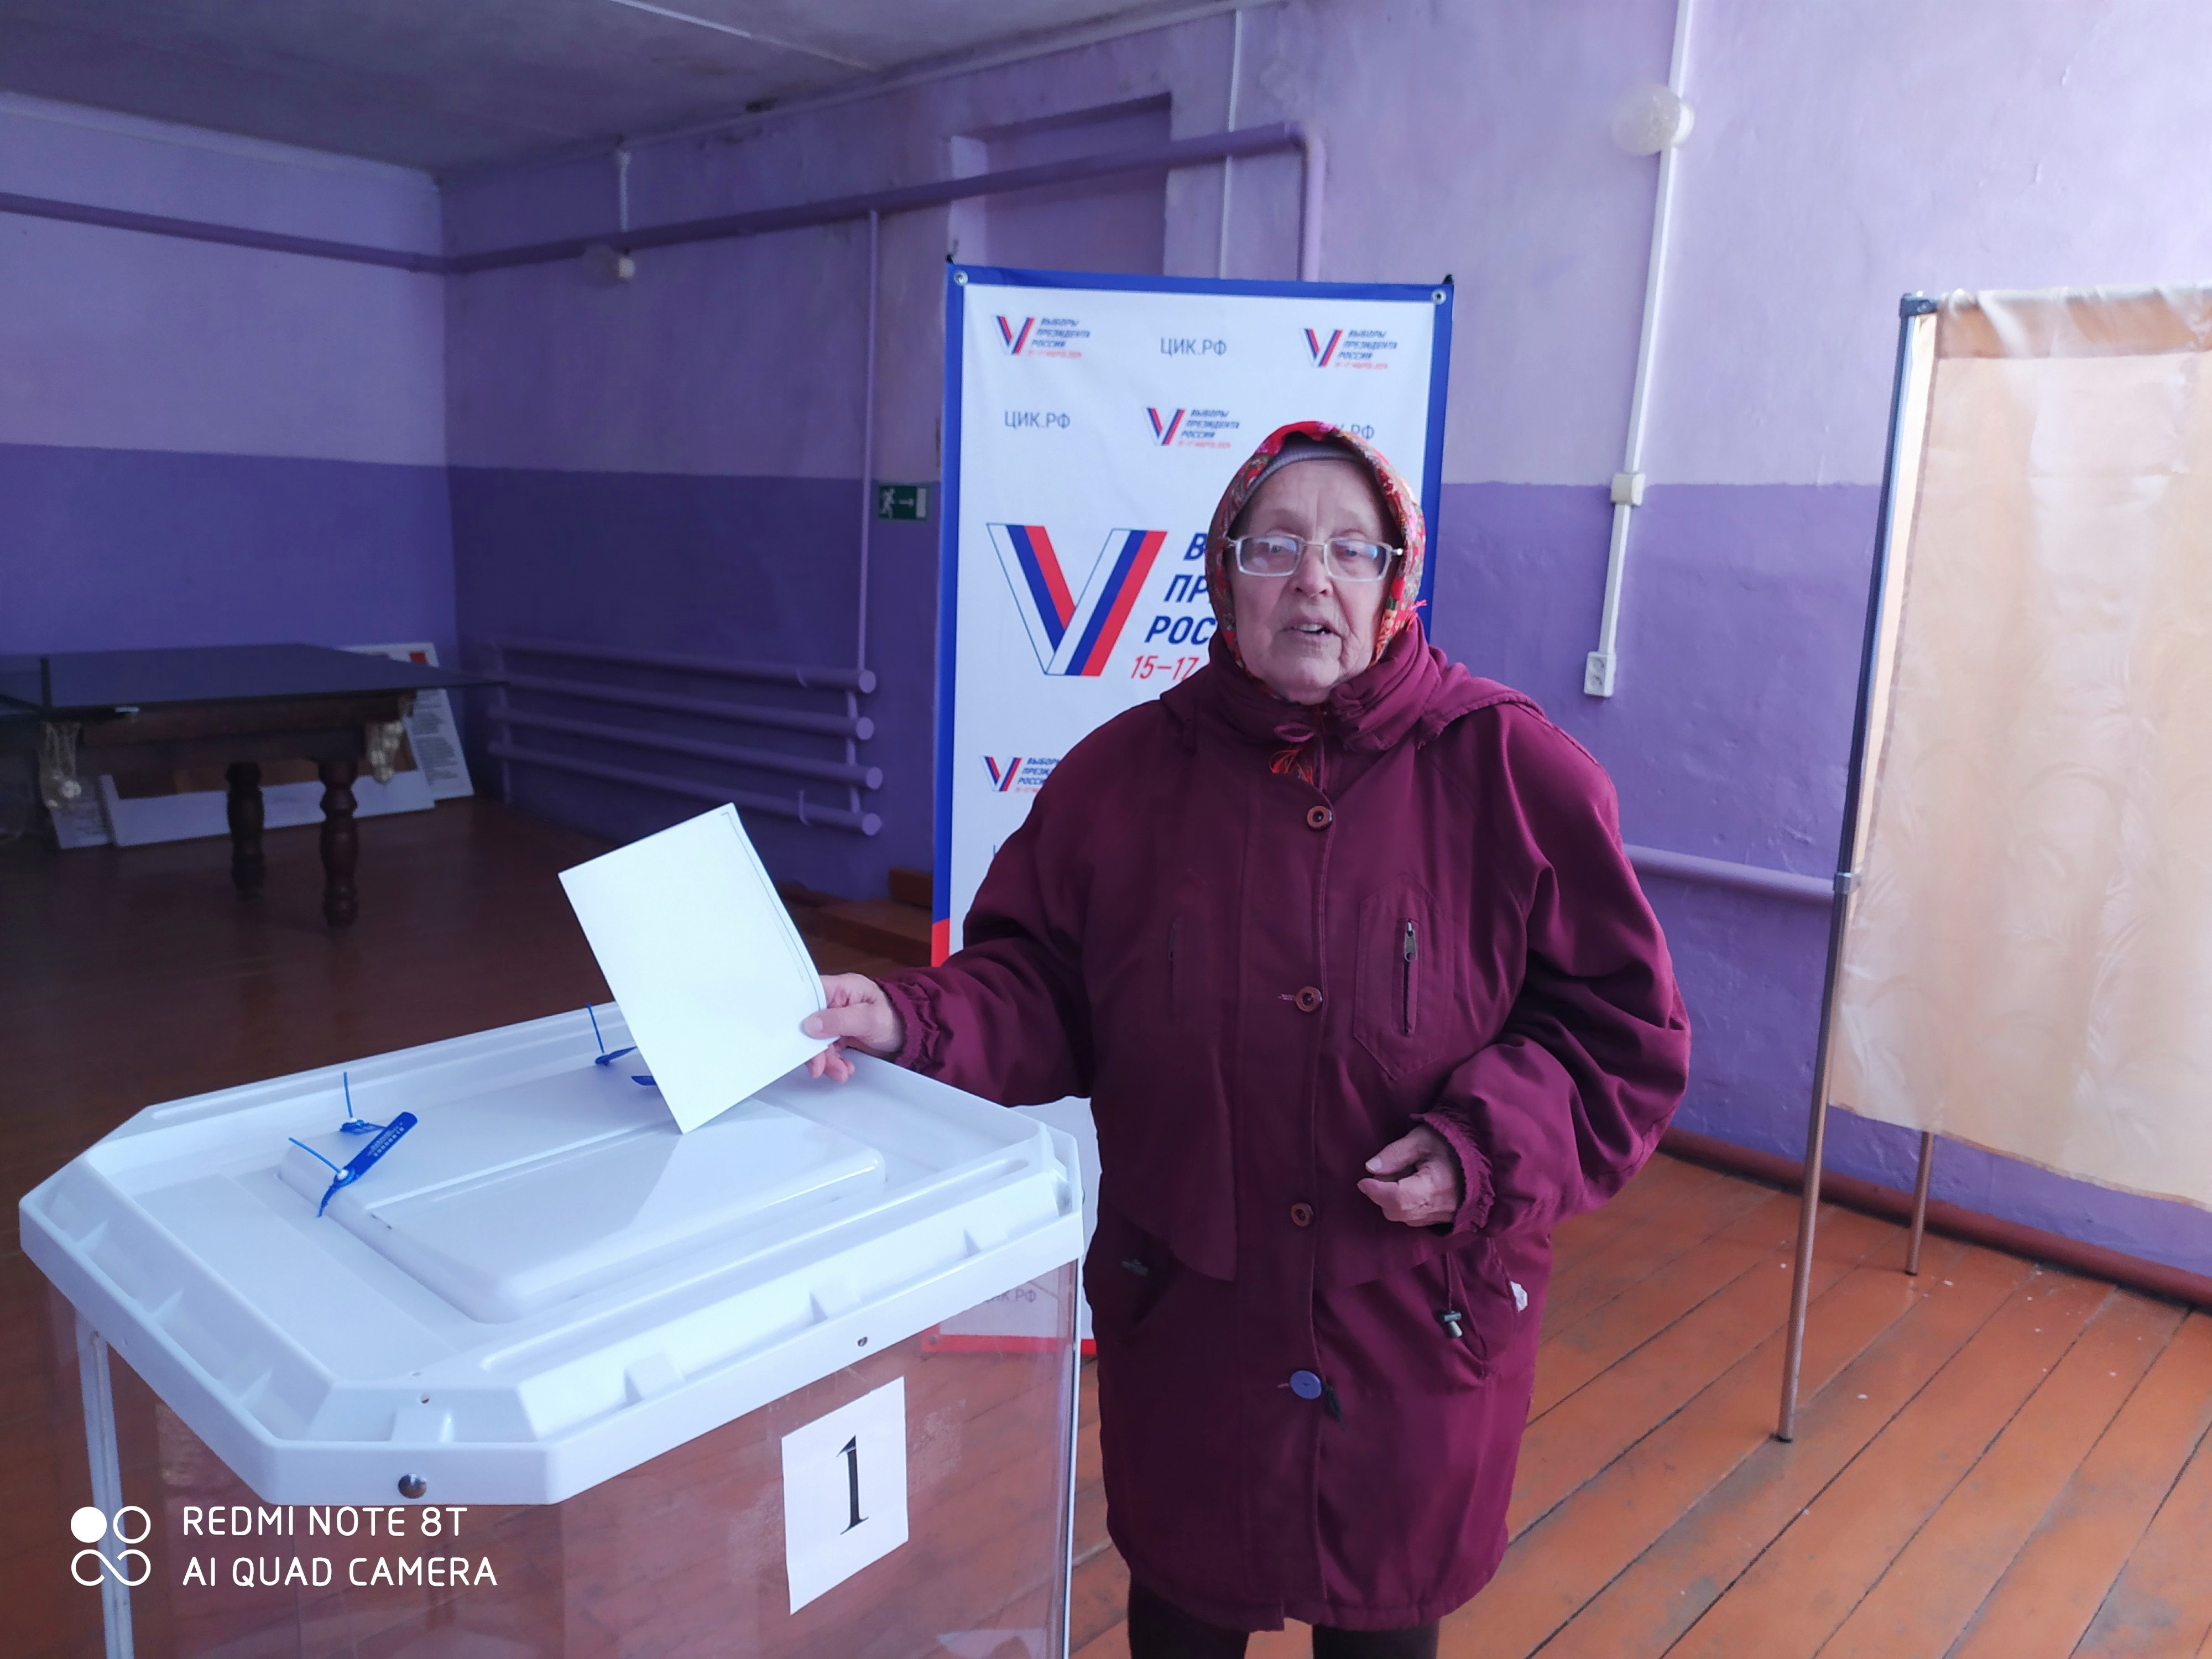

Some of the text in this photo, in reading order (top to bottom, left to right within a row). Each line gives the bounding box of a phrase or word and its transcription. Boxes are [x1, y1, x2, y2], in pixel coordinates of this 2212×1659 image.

[1161, 338, 1228, 357] ЦИК.РФ
[1005, 411, 1071, 429] ЦИК.РФ
[1144, 615, 1216, 645] РОС
[836, 1434, 869, 1536] 1
